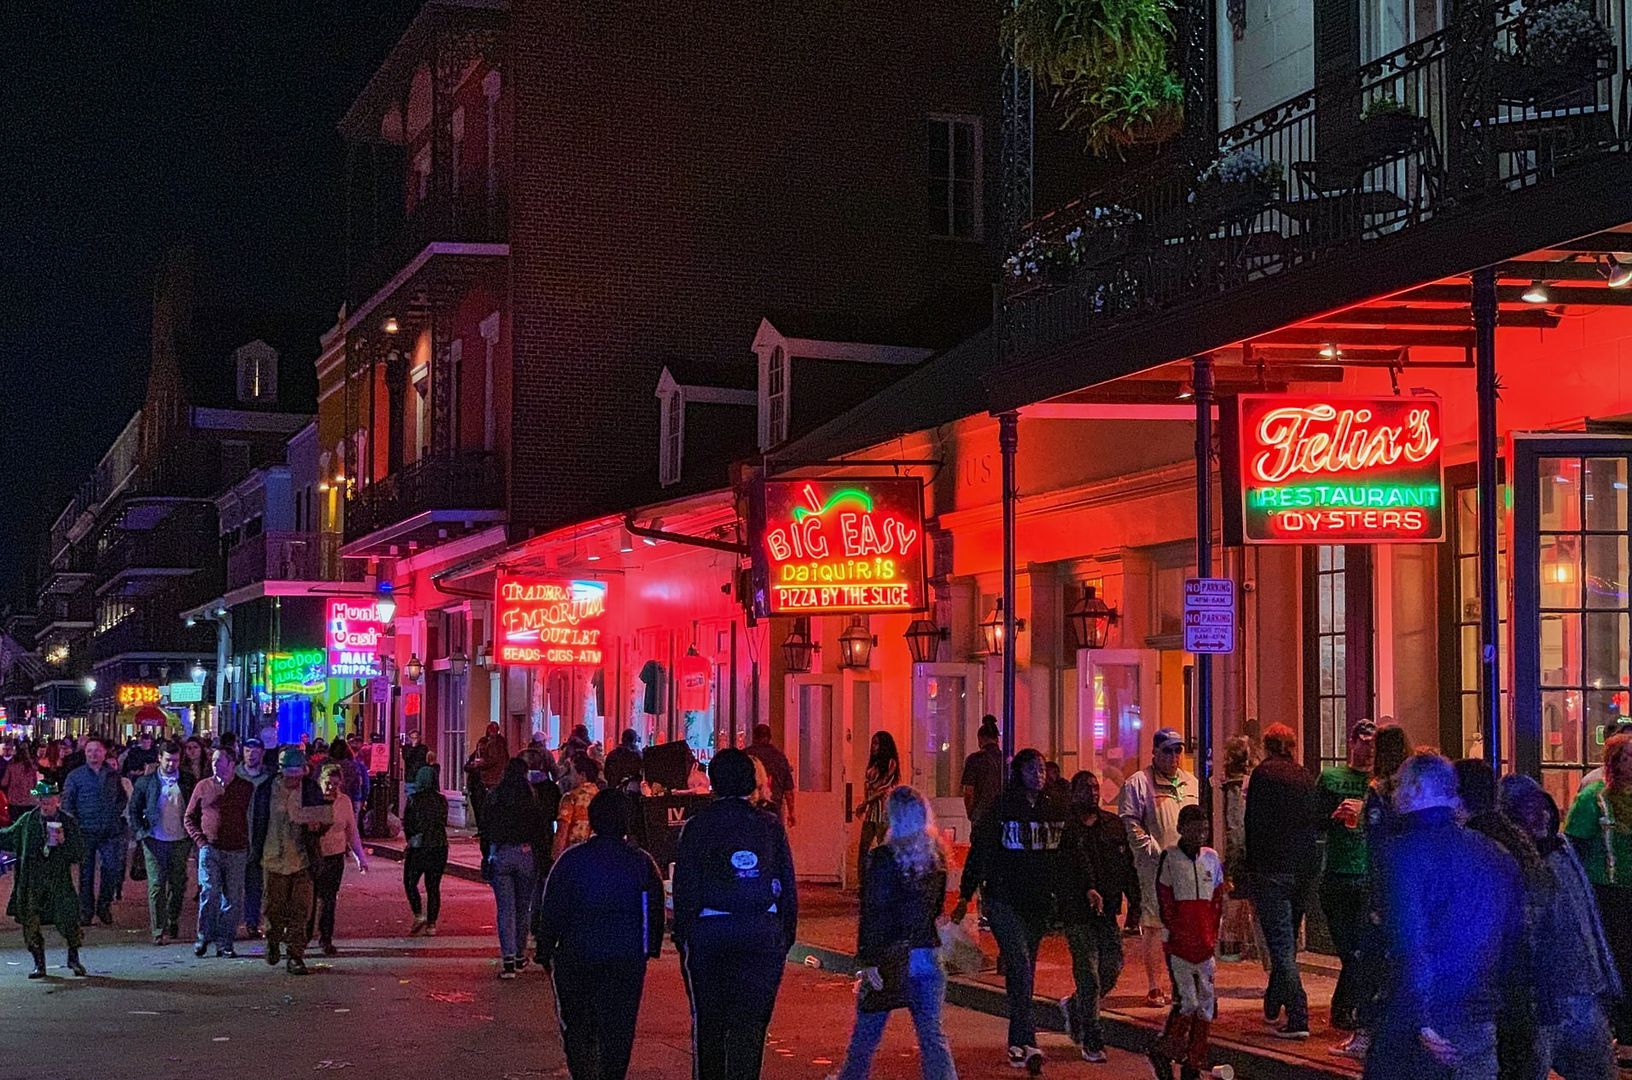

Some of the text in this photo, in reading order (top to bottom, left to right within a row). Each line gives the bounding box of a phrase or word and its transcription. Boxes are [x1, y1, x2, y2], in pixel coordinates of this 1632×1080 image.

[1252, 404, 1439, 482] Felix's
[1255, 486, 1439, 506] RESTAURANT
[1281, 510, 1422, 531] OYSTERS
[767, 513, 917, 561] BIG EASY
[780, 586, 909, 607] PIZZA BY THE SLICE
[1186, 582, 1231, 593] NO PARKING
[1186, 613, 1231, 623] NO PARKING
[540, 628, 600, 645] OUTLET
